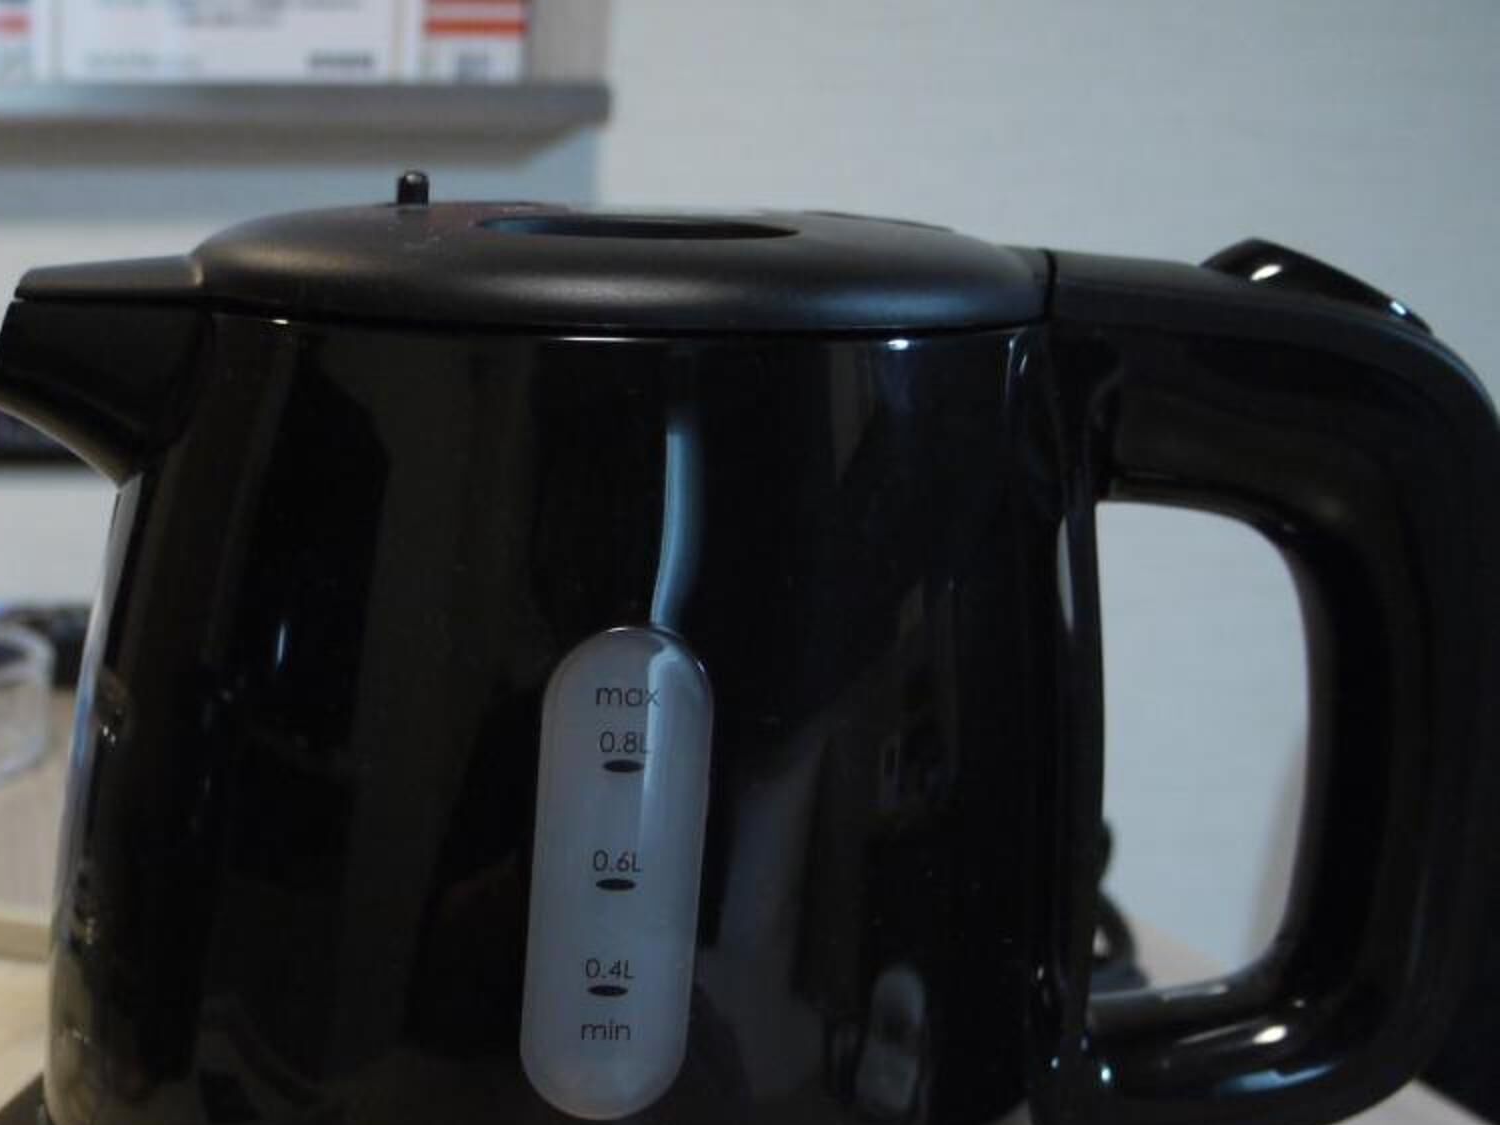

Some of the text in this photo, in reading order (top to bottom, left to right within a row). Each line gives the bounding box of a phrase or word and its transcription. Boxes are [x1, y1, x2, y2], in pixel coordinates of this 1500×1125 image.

[595, 687, 660, 708] max
[599, 731, 649, 754] 0.8L
[592, 850, 642, 872] 0.6L
[585, 958, 635, 980] 0.4L
[580, 1020, 631, 1041] min
